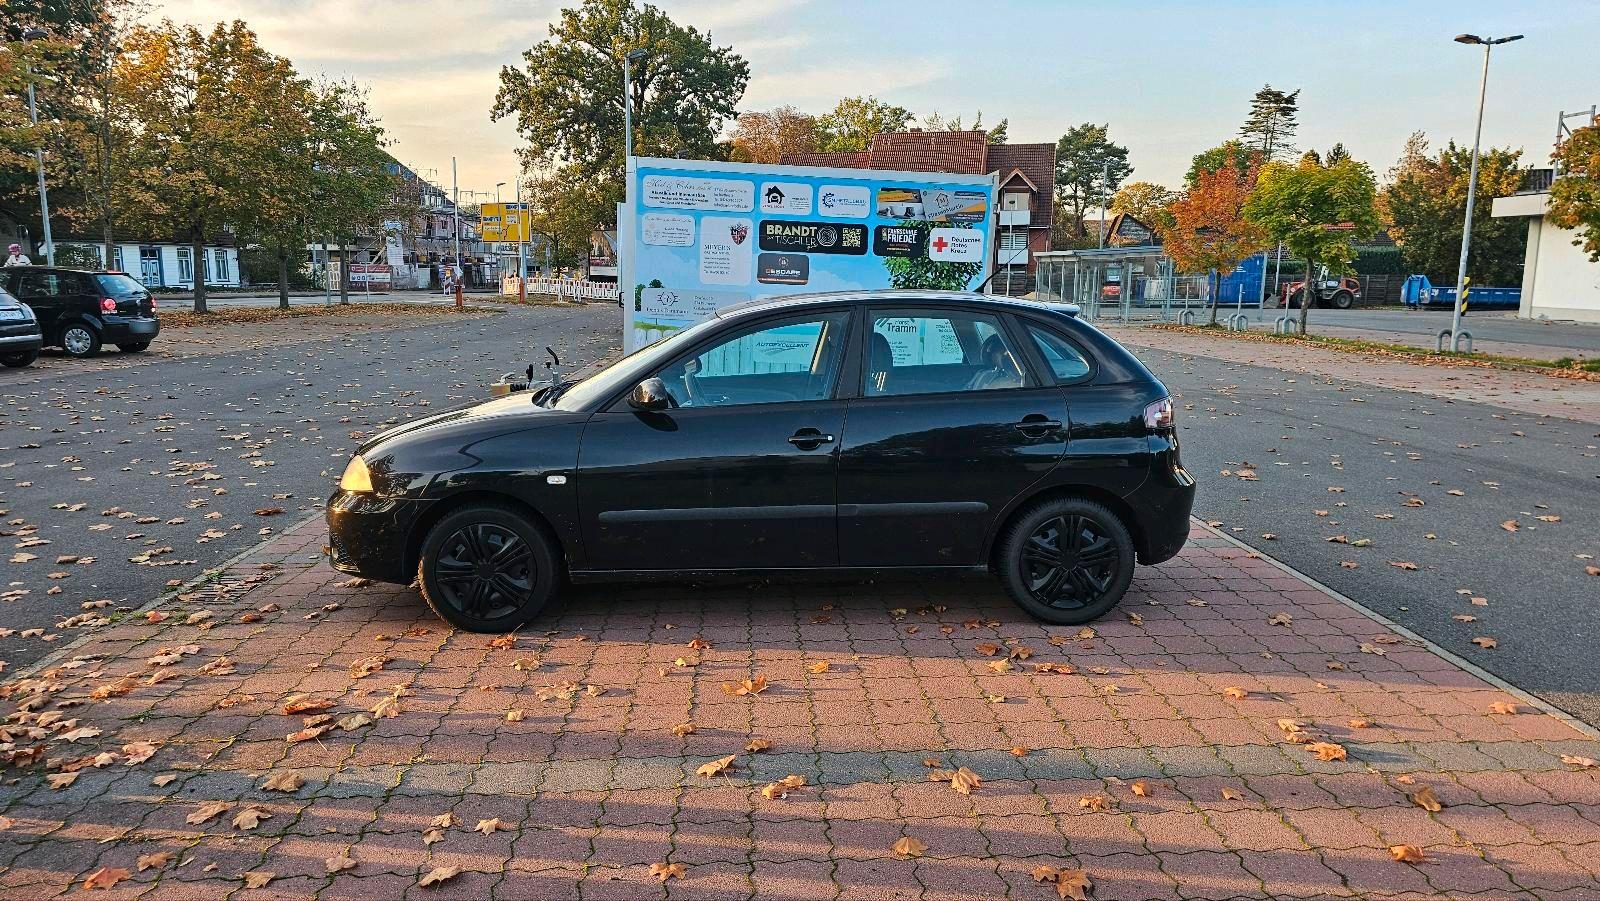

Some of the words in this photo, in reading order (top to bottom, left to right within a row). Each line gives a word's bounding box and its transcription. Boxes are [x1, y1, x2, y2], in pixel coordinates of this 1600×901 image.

[766, 224, 818, 237] BRANDT
[887, 228, 918, 236] FAHRSCHULE
[775, 235, 816, 246] TISCHLER
[887, 234, 917, 244] FRIEDEL
[886, 322, 917, 333] Tramm
